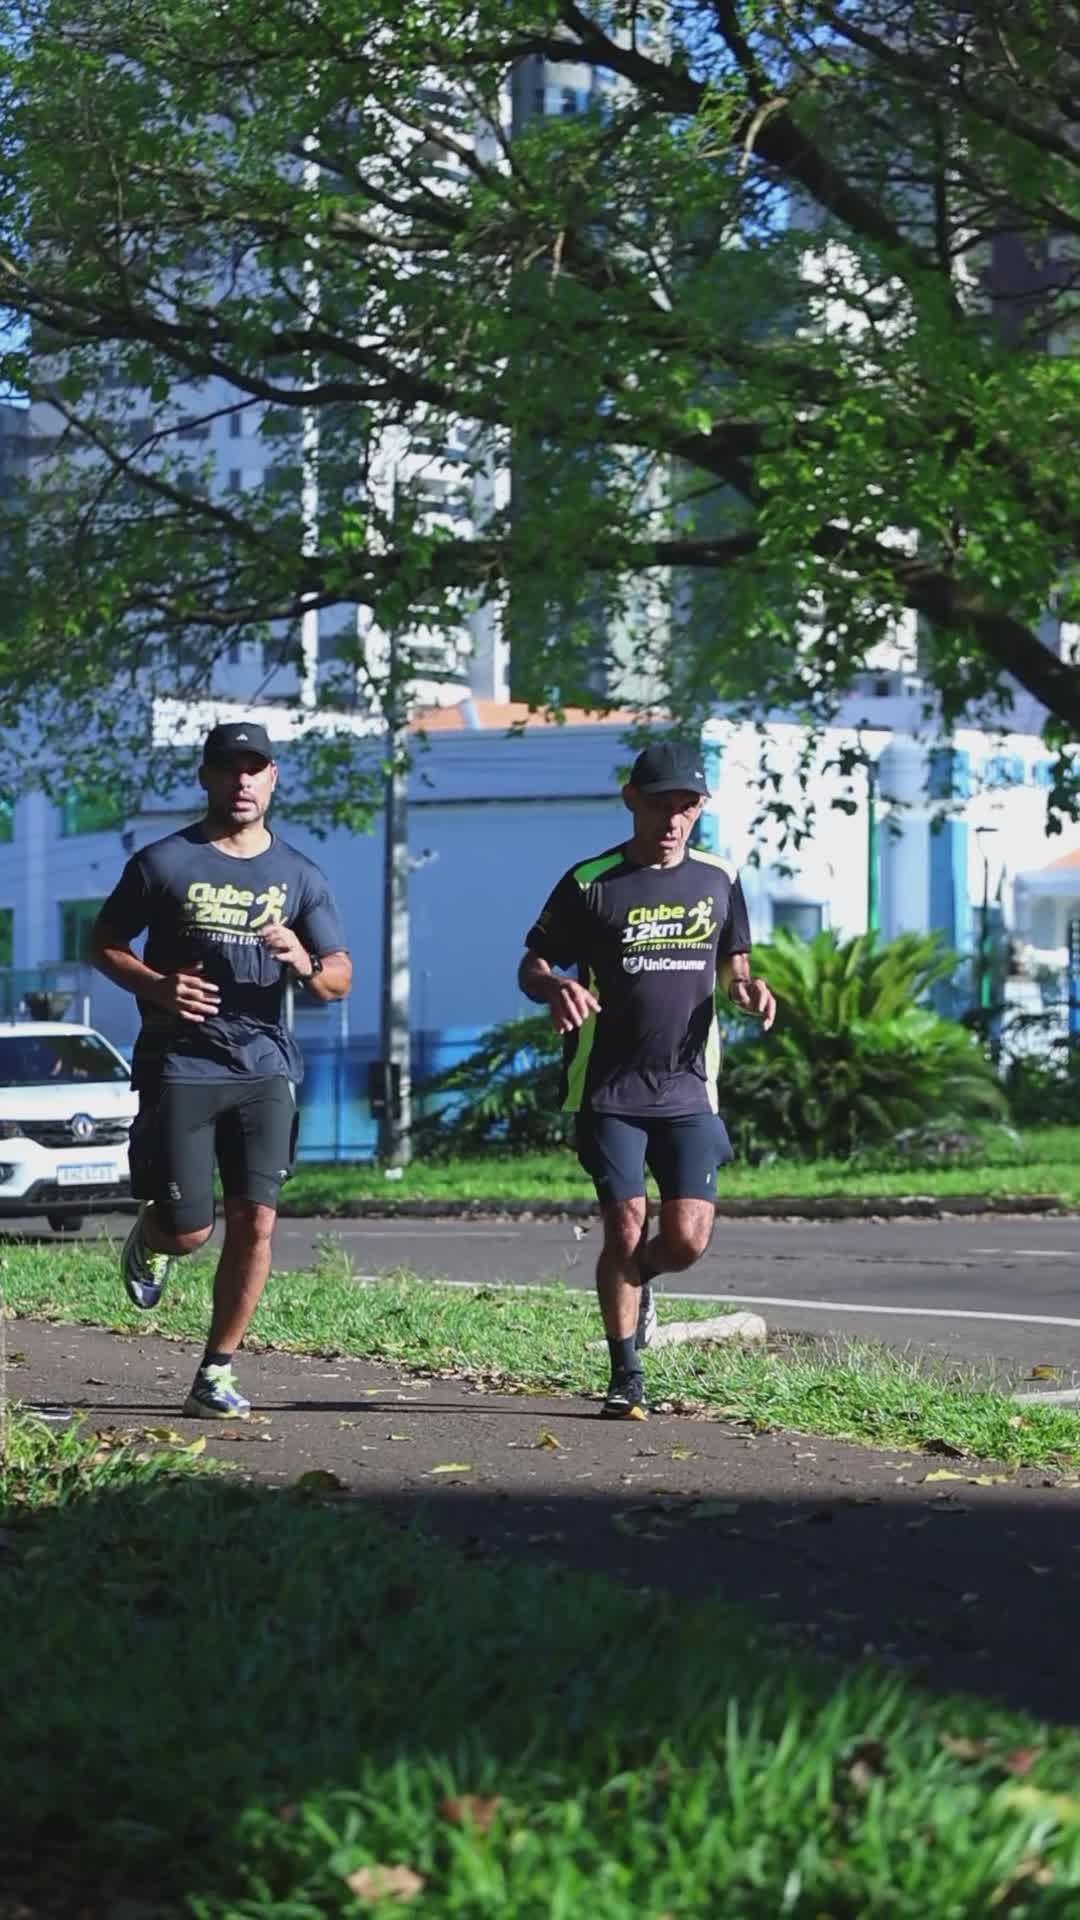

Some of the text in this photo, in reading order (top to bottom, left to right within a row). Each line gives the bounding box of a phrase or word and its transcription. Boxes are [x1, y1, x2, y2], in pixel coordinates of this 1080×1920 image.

[188, 882, 254, 906] Clube
[628, 905, 685, 925] Clube
[622, 922, 682, 943] 12km
[643, 957, 706, 971] UniCesumar
